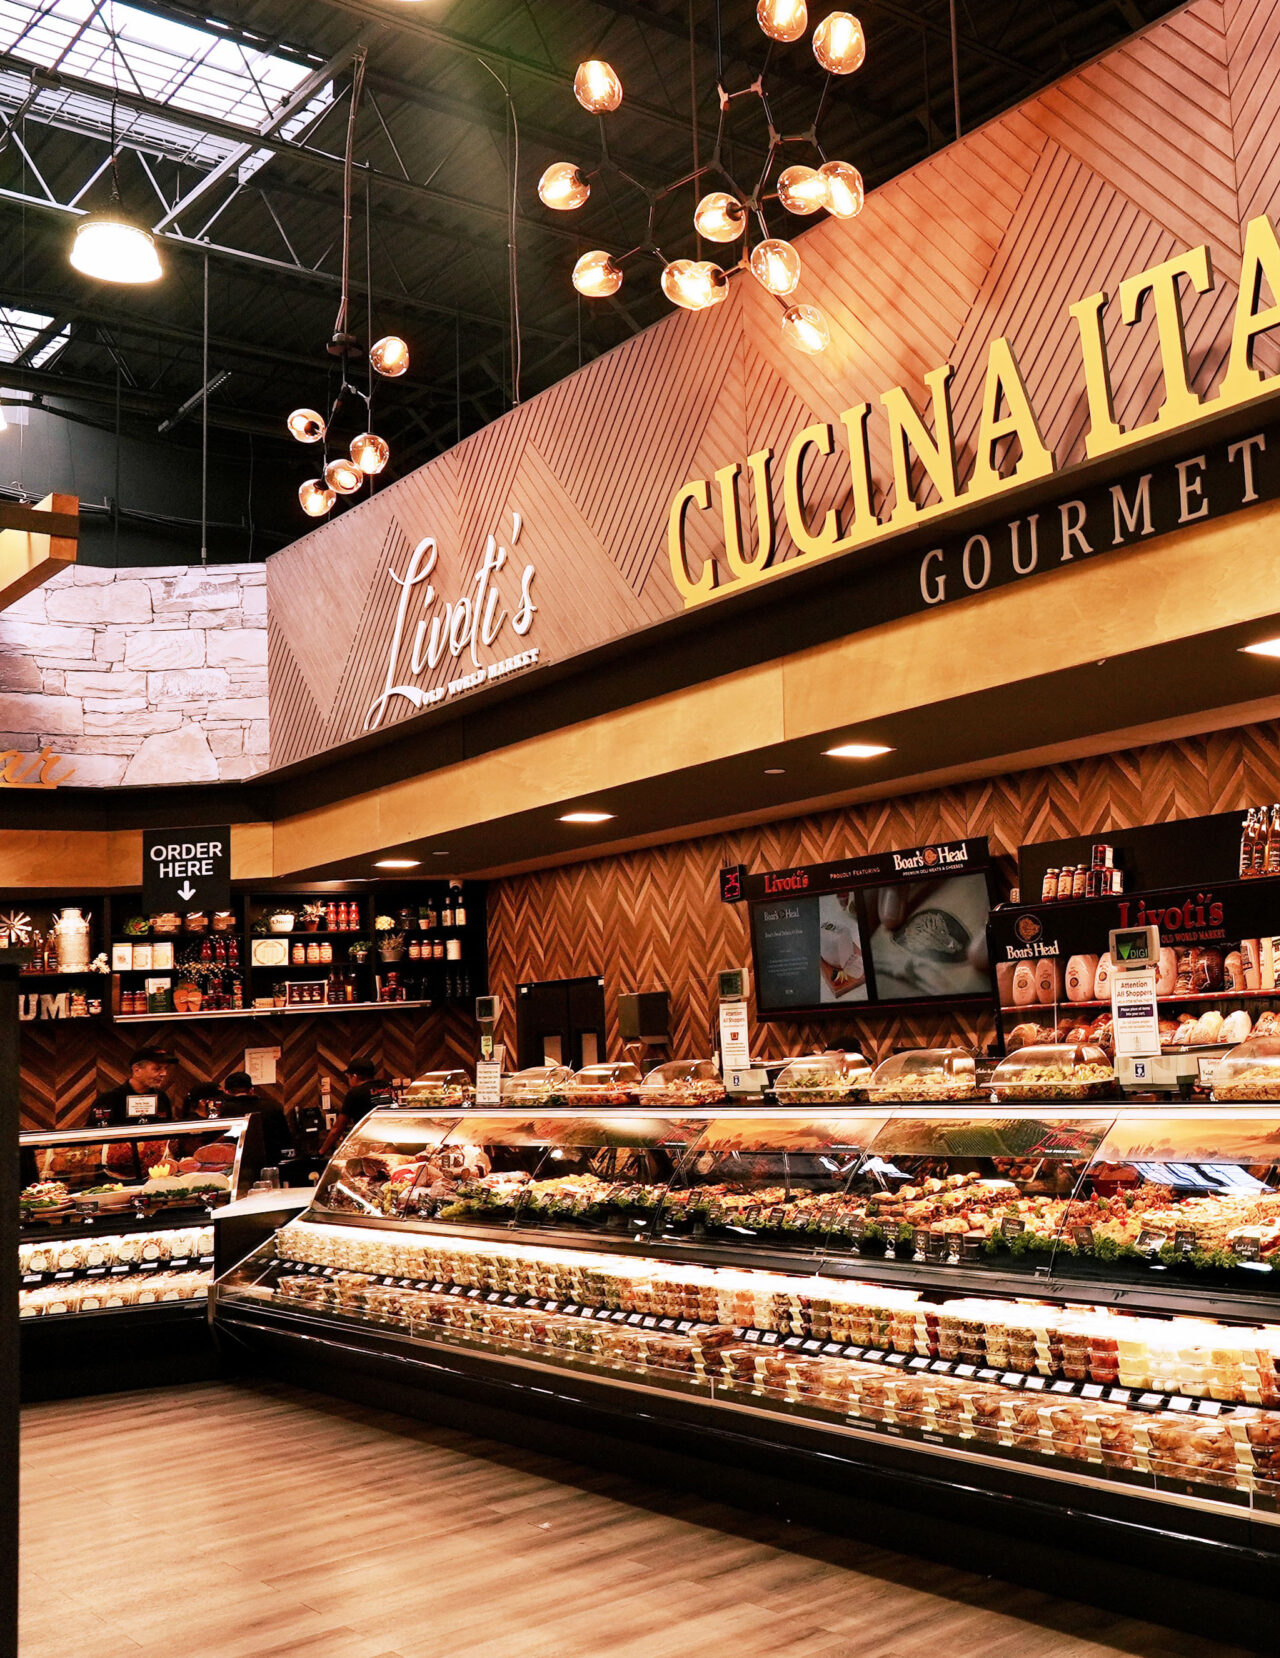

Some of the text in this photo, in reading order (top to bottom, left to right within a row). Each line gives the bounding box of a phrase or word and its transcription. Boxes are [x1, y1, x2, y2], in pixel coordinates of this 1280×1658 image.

[668, 337, 1057, 607] CUCINA
[919, 433, 1267, 605] GOURMET
[364, 512, 537, 730] Livoti's
[150, 841, 222, 861] ORDER
[893, 843, 969, 870] Boar's Head
[159, 860, 214, 878] HERE
[764, 870, 810, 894] Livoti's
[1117, 893, 1224, 930] Livoti's
[1006, 940, 1060, 960] Boar's Head
[1130, 948, 1148, 959] DIGI
